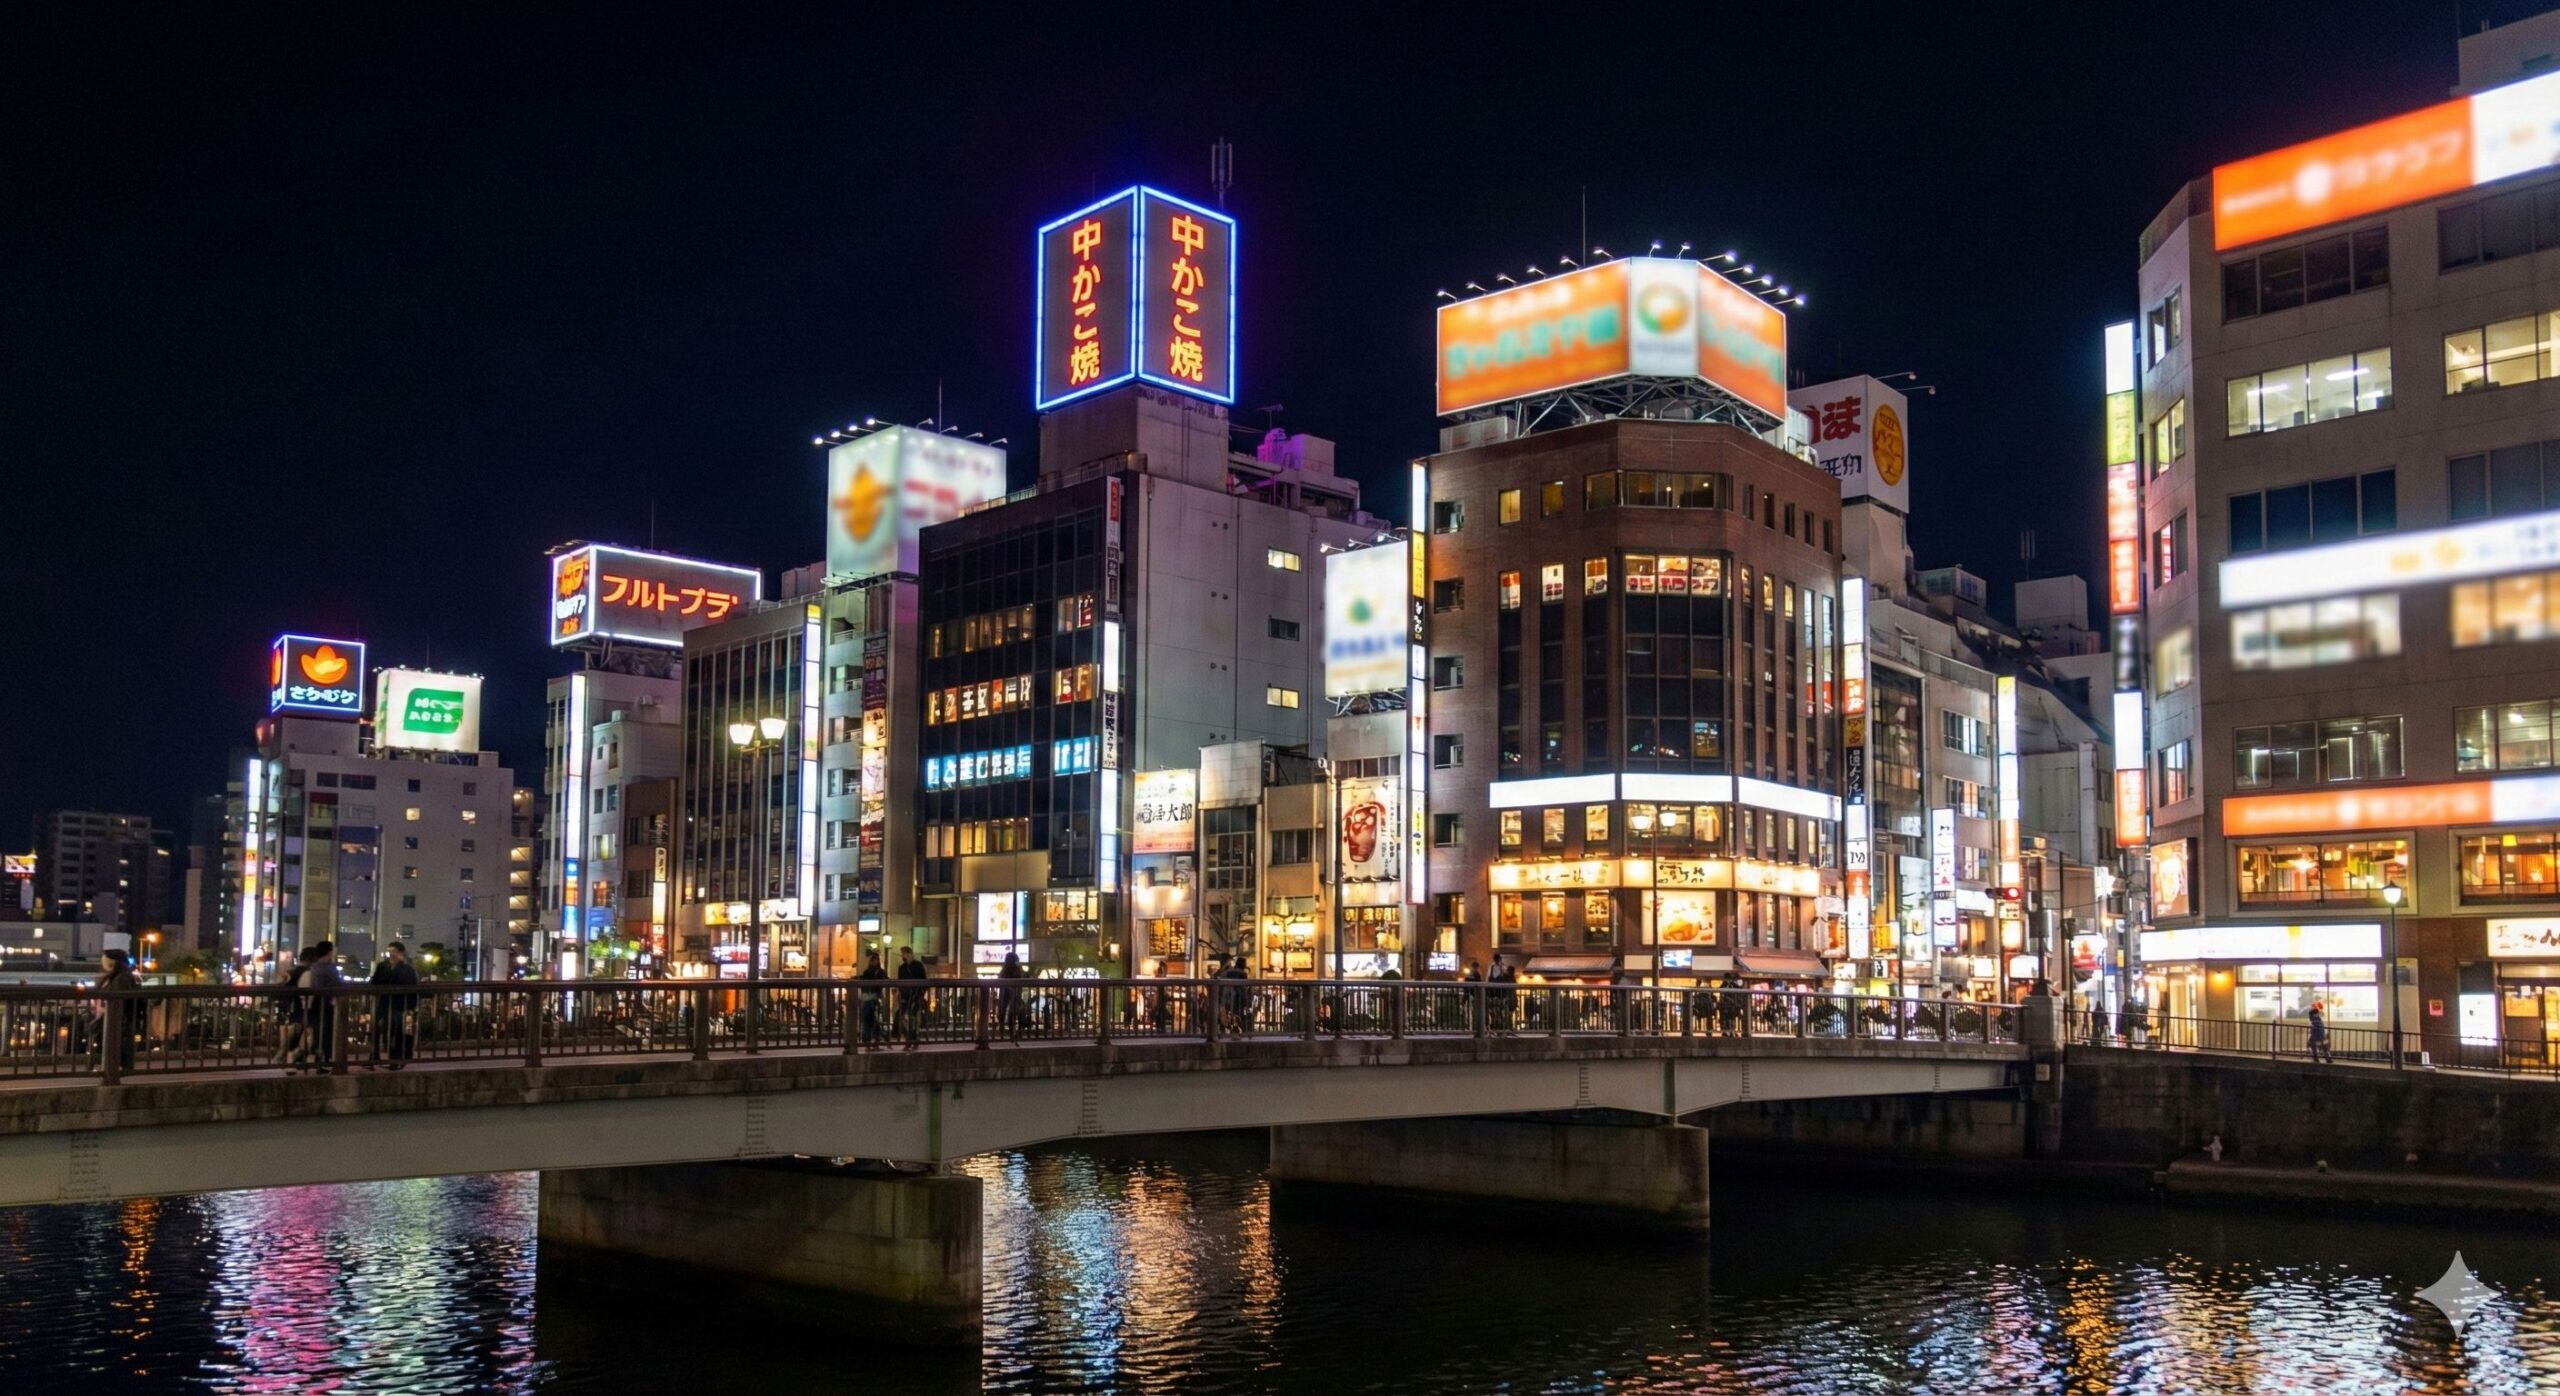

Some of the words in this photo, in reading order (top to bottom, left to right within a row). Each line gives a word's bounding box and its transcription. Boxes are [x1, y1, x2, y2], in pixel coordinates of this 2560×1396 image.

[1070, 219, 1102, 385] 中かこ焼
[1169, 215, 1205, 382] 中かこ焼
